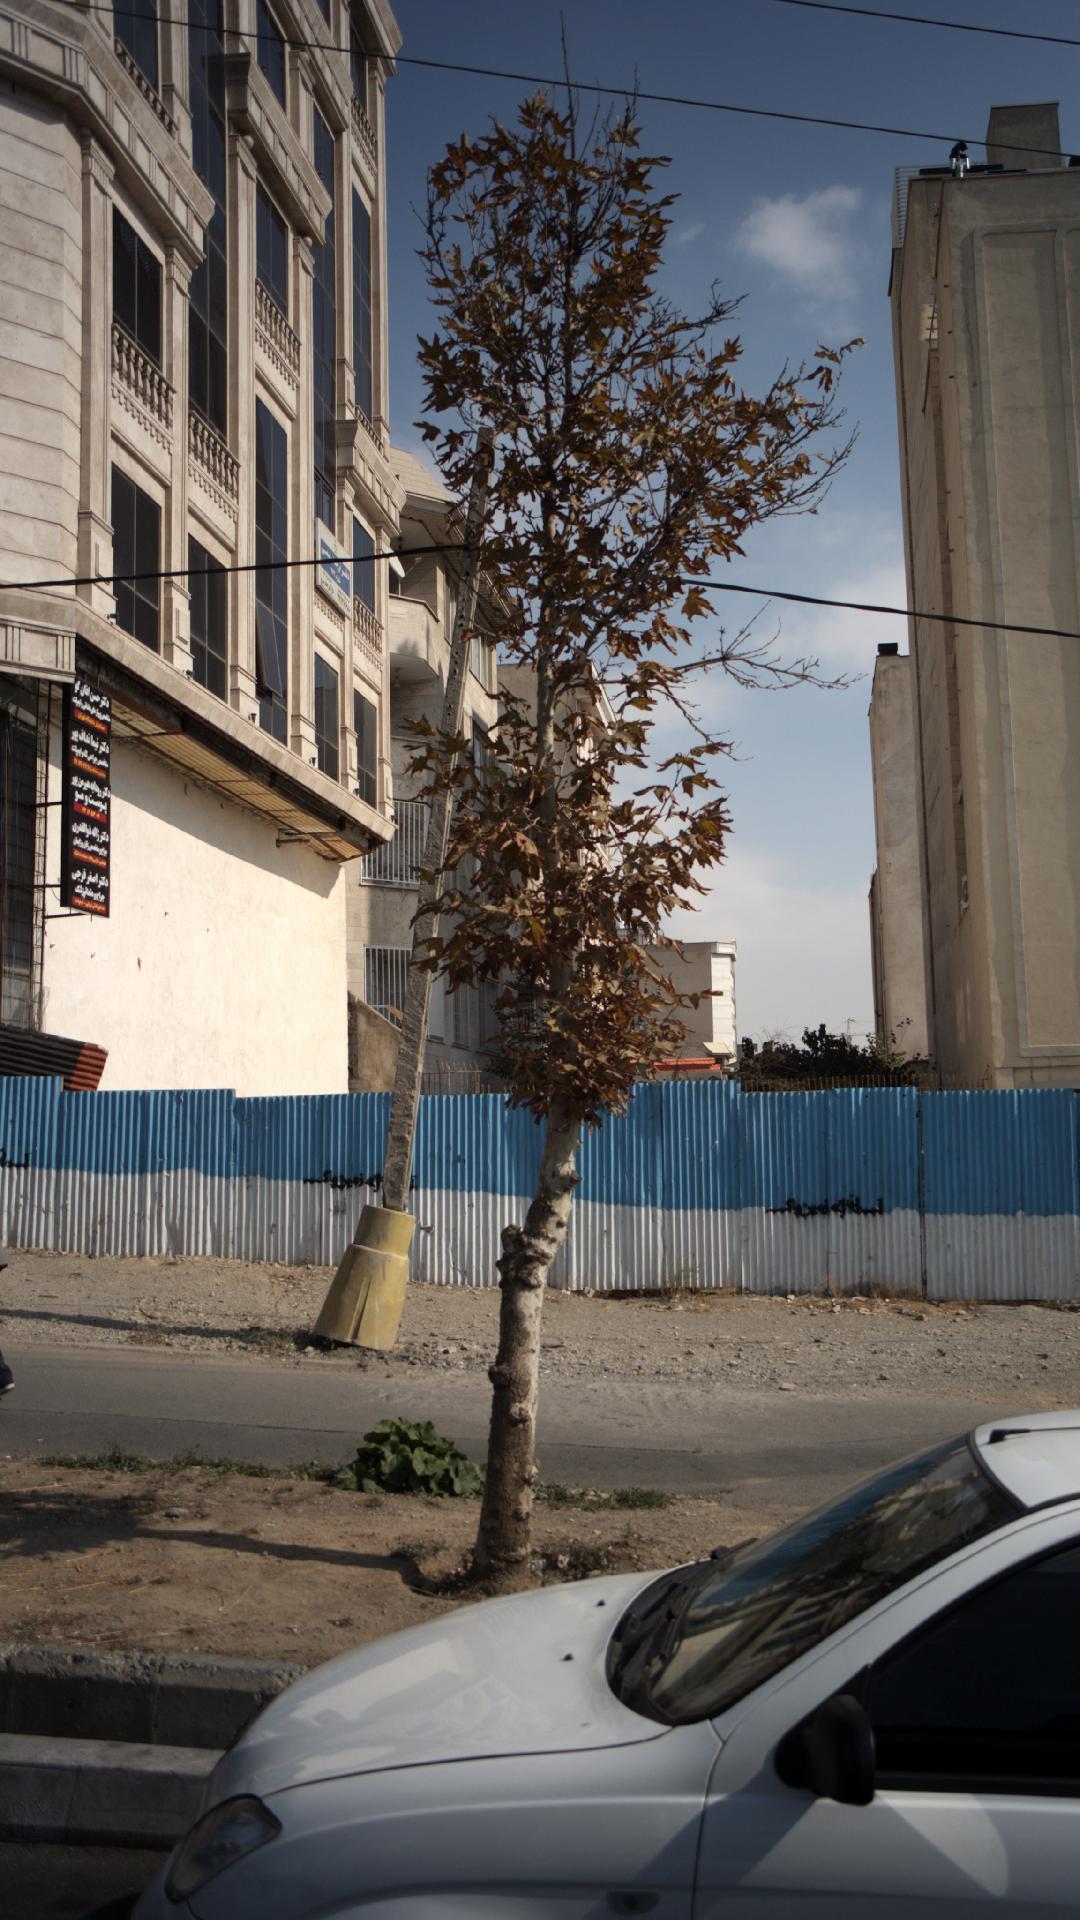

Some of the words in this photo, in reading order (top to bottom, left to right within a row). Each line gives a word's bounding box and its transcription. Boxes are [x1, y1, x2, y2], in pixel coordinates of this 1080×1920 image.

[99, 741, 109, 754] دکتر
[74, 790, 85, 802] مو
[88, 794, 108, 815] پوست
[99, 831, 109, 843] دکتر
[98, 875, 109, 888] دکتر
